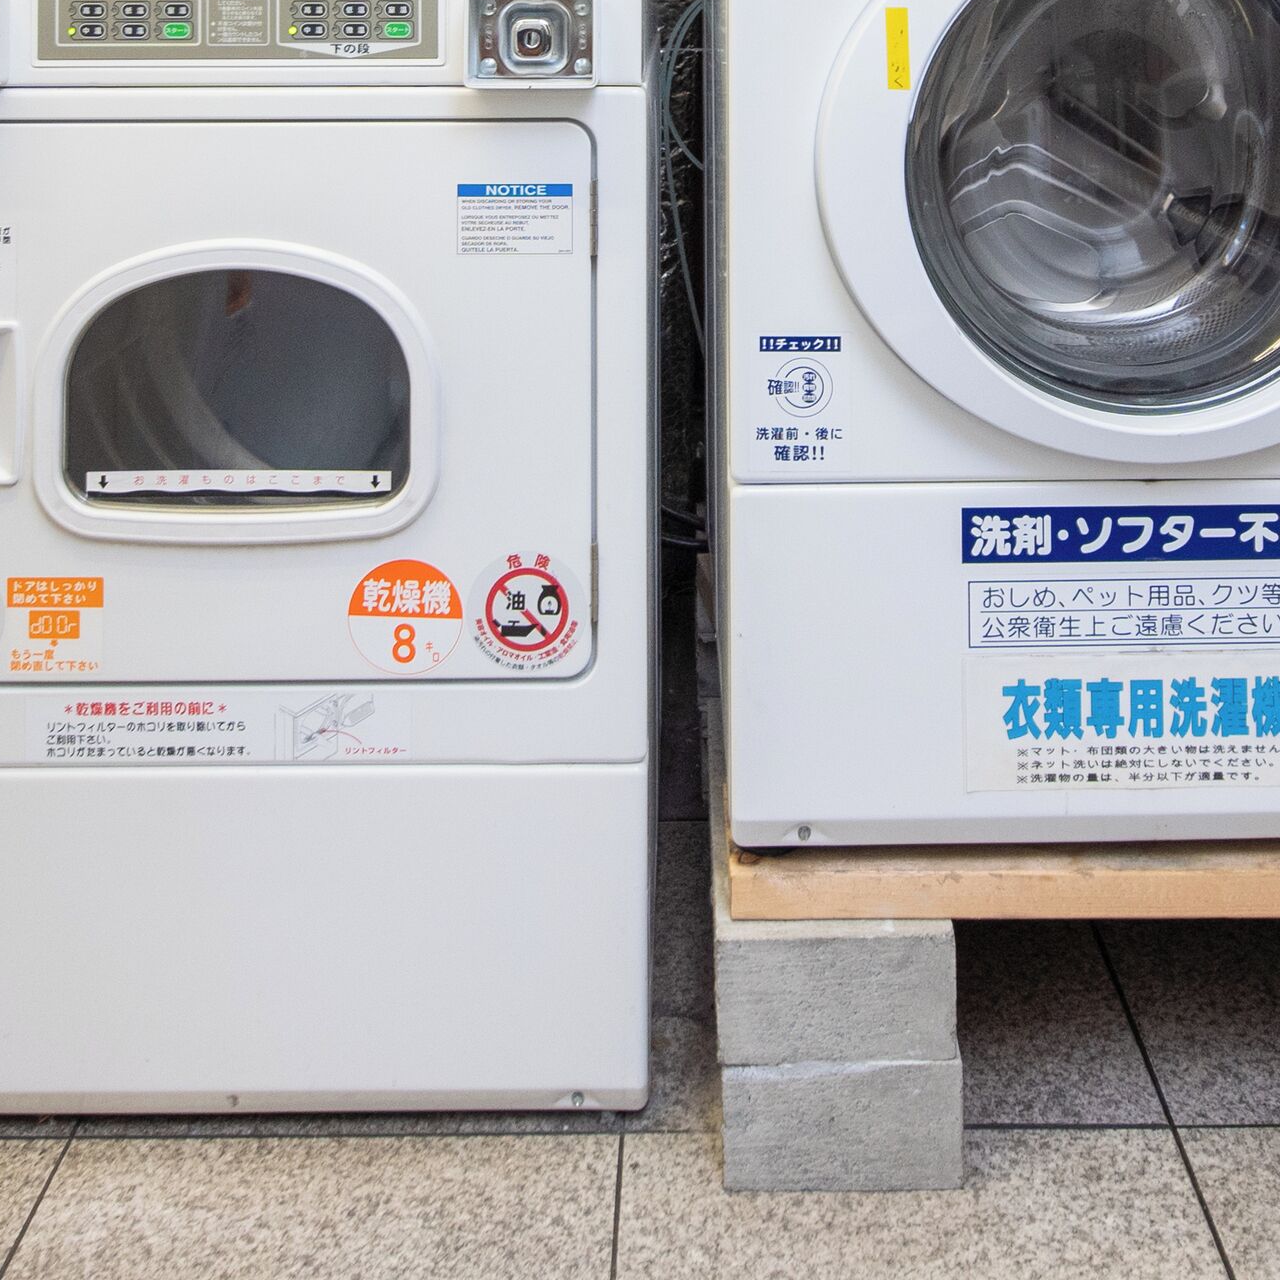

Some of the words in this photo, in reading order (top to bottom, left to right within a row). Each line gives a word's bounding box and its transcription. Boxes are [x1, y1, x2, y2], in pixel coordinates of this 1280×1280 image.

[330, 44, 370, 53] 下の段
[486, 185, 547, 195] NOTICE
[756, 427, 843, 440] 洗濯前・後に
[774, 445, 825, 461] 確認!!
[13, 580, 97, 592] ドアはしっかり
[13, 593, 86, 604] 閉めて下さい
[363, 579, 451, 614] 乾燥機
[506, 591, 525, 611] 油
[392, 623, 416, 664] 8
[11, 650, 54, 660] もう一度
